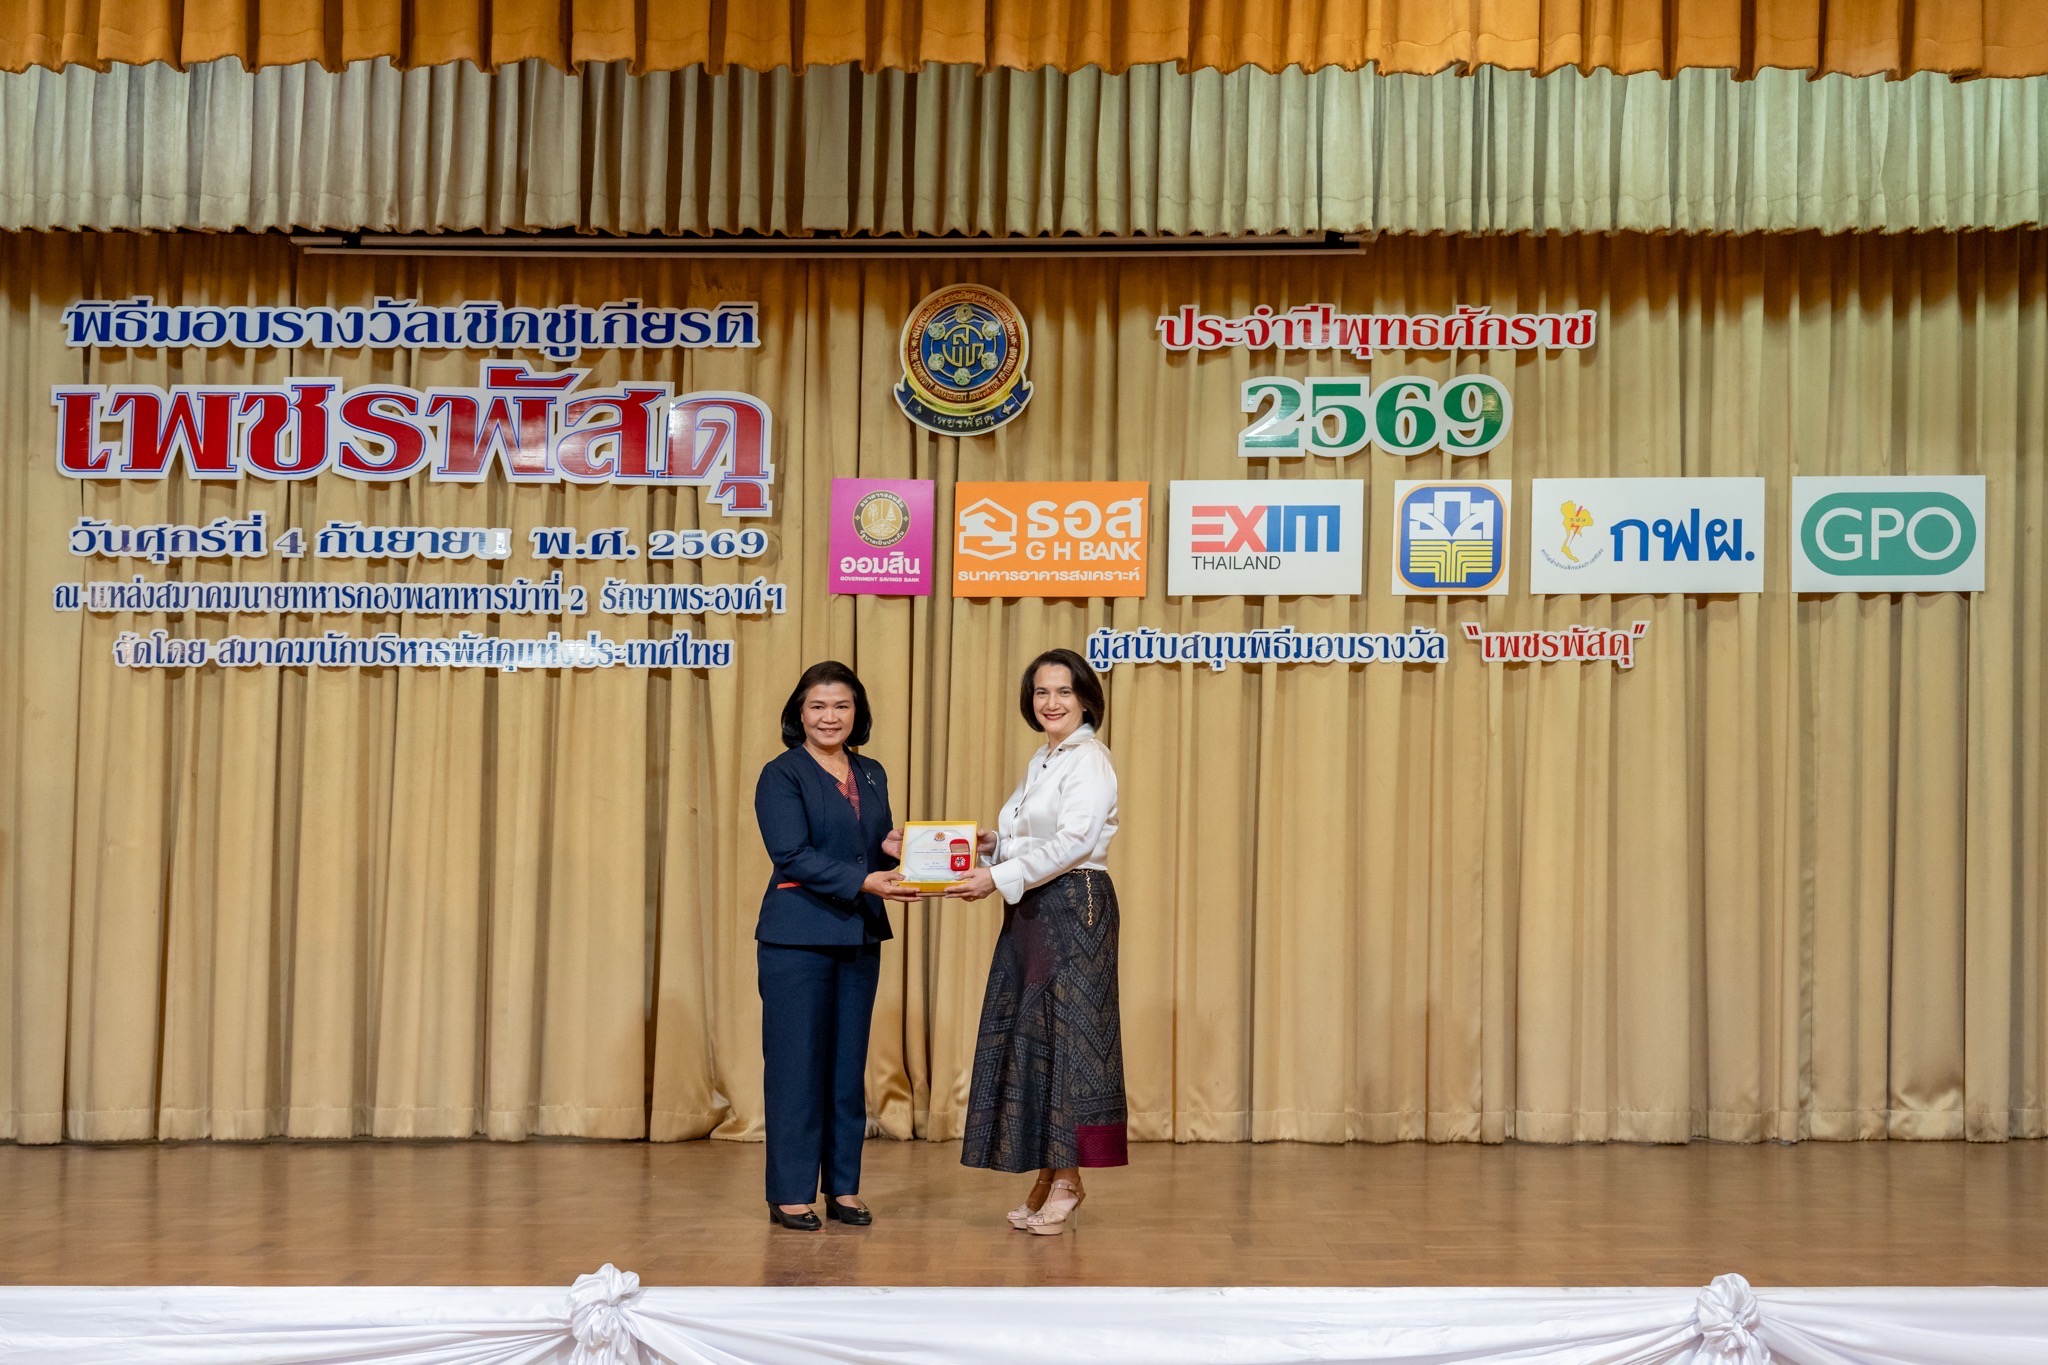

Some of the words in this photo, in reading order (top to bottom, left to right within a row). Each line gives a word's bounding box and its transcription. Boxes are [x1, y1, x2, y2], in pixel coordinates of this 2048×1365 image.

[66, 299, 757, 357] พิธีมอบรางวัลเชิดชูเกียรติ
[1160, 304, 1594, 356] ประจำปีพุทธศักราช
[56, 366, 770, 512] เพชรพัสดุ
[1244, 382, 1504, 449] 2569
[71, 514, 264, 562] วันศุกร์ที่
[276, 531, 304, 555] 4
[533, 529, 637, 557] พ.ศ.
[650, 531, 767, 556] 2569
[1079, 541, 1142, 561] BANK
[1191, 504, 1341, 553] EXIM
[1609, 507, 1756, 562] กฟผ.
[1815, 506, 1963, 562] GPO
[840, 551, 921, 575] ออมสิน
[958, 566, 1141, 582] ธนาคารอาคารสงเคราะห์
[1191, 555, 1282, 571] THAILAND
[55, 584, 80, 609] ณ
[570, 587, 585, 611] 2
[115, 631, 206, 665] จัดโดย
[1088, 628, 1446, 669] ผู้สนับสนุนพิธีมอบรางวัล
